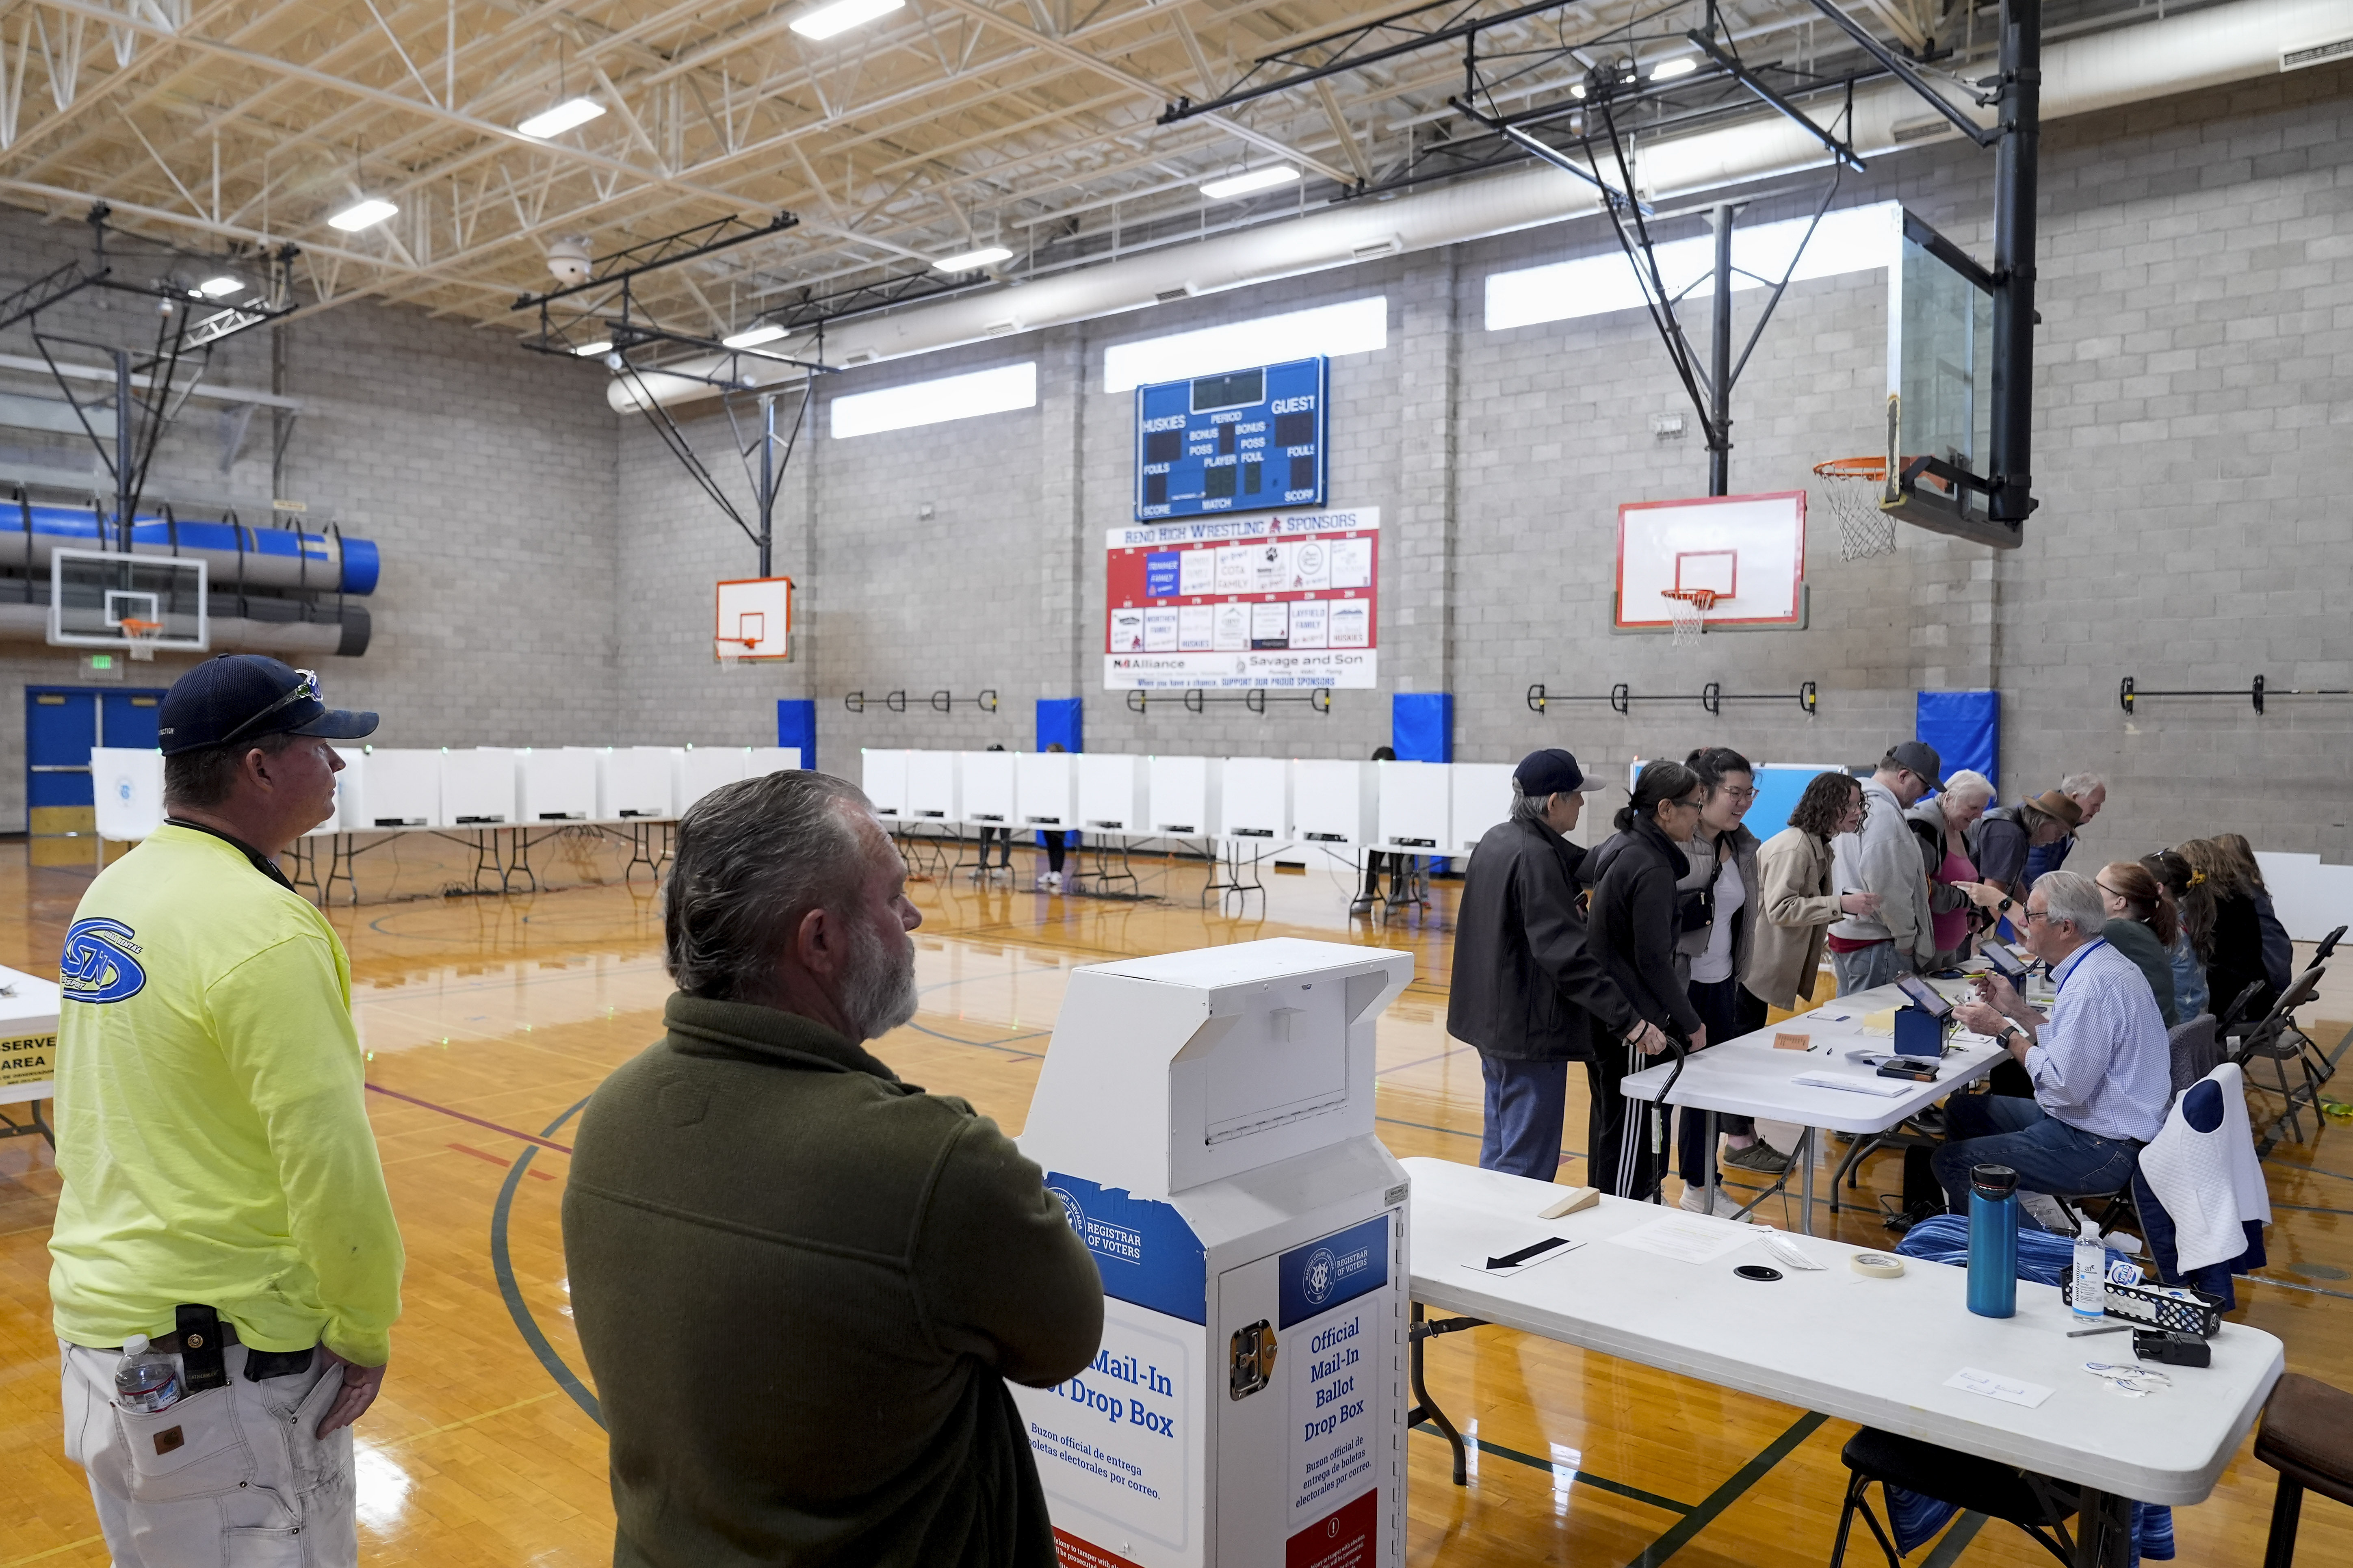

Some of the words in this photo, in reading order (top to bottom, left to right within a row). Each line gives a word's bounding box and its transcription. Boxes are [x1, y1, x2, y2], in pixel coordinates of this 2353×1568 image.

[1271, 395, 1315, 414] GUEST
[1143, 414, 1186, 433] HUSKIES
[1211, 411, 1243, 424] PERIOD
[1189, 428, 1219, 441] BONUS
[1235, 421, 1266, 435] BONUS
[1189, 443, 1213, 456] POSS
[1240, 437, 1266, 449] POSS
[1204, 454, 1237, 468] PLAYER
[1241, 451, 1265, 463] FOUL
[1143, 462, 1170, 475] FOULS
[1143, 504, 1171, 516] SCORE
[1202, 498, 1232, 510] MATCH
[1125, 531, 1155, 544] RENO
[1159, 528, 1186, 541] HIGH
[1191, 521, 1264, 538] WRESTLING
[1287, 514, 1356, 531] SPONSORS
[1292, 609, 1325, 618] LAYFIELD
[1250, 656, 1298, 667] Savage
[1303, 655, 1330, 665] and
[1335, 654, 1363, 664] Son
[1222, 678, 1252, 686] SUPPORT
[1254, 678, 1268, 686] OUR
[1271, 678, 1294, 686] PROUD
[1297, 677, 1335, 686] SPONSORS
[117, 937, 143, 954] RENTAL
[0, 1037, 55, 1051] SERVE
[2, 1056, 46, 1070] AREA
[1070, 1202, 1082, 1230] NEVADA
[1087, 1222, 1141, 1246] REGISTRAR
[1088, 1235, 1100, 1246] OF
[1102, 1238, 1140, 1258] VOTERS
[1337, 1250, 1367, 1268] REGISTRAR
[1337, 1267, 1345, 1276] OF
[1346, 1258, 1367, 1273] VOTERS
[1311, 1317, 1359, 1354] Official
[1088, 1349, 1173, 1397] Mail-In
[1311, 1348, 1359, 1383] Mail-In
[1316, 1375, 1354, 1408] Ballot
[1071, 1377, 1123, 1423] Drop
[1129, 1398, 1174, 1438] Box
[1304, 1414, 1336, 1442] Drop
[1340, 1399, 1364, 1424] Box
[1031, 1422, 1058, 1442] Buzon
[1060, 1436, 1091, 1455] official
[1094, 1448, 1104, 1460] de
[1107, 1454, 1142, 1476] entrega
[1306, 1456, 1328, 1474] Buzon
[1330, 1440, 1354, 1460] official
[1355, 1436, 1363, 1446] de
[1060, 1451, 1108, 1477] electorales
[1110, 1472, 1129, 1485] por
[1128, 1479, 1161, 1500] correo.
[1303, 1469, 1330, 1489] entrega
[1332, 1463, 1340, 1474] de
[1341, 1449, 1365, 1469] boletas
[1296, 1481, 1334, 1508] electorales
[1336, 1473, 1347, 1488] por
[1349, 1461, 1371, 1478] correo.
[1060, 1549, 1066, 1557] be
[1328, 1549, 1341, 1560] tamper
[1341, 1542, 1350, 1552] with
[1350, 1534, 1365, 1546] election
[1077, 1548, 1097, 1562] tamper
[1098, 1557, 1110, 1568] with
